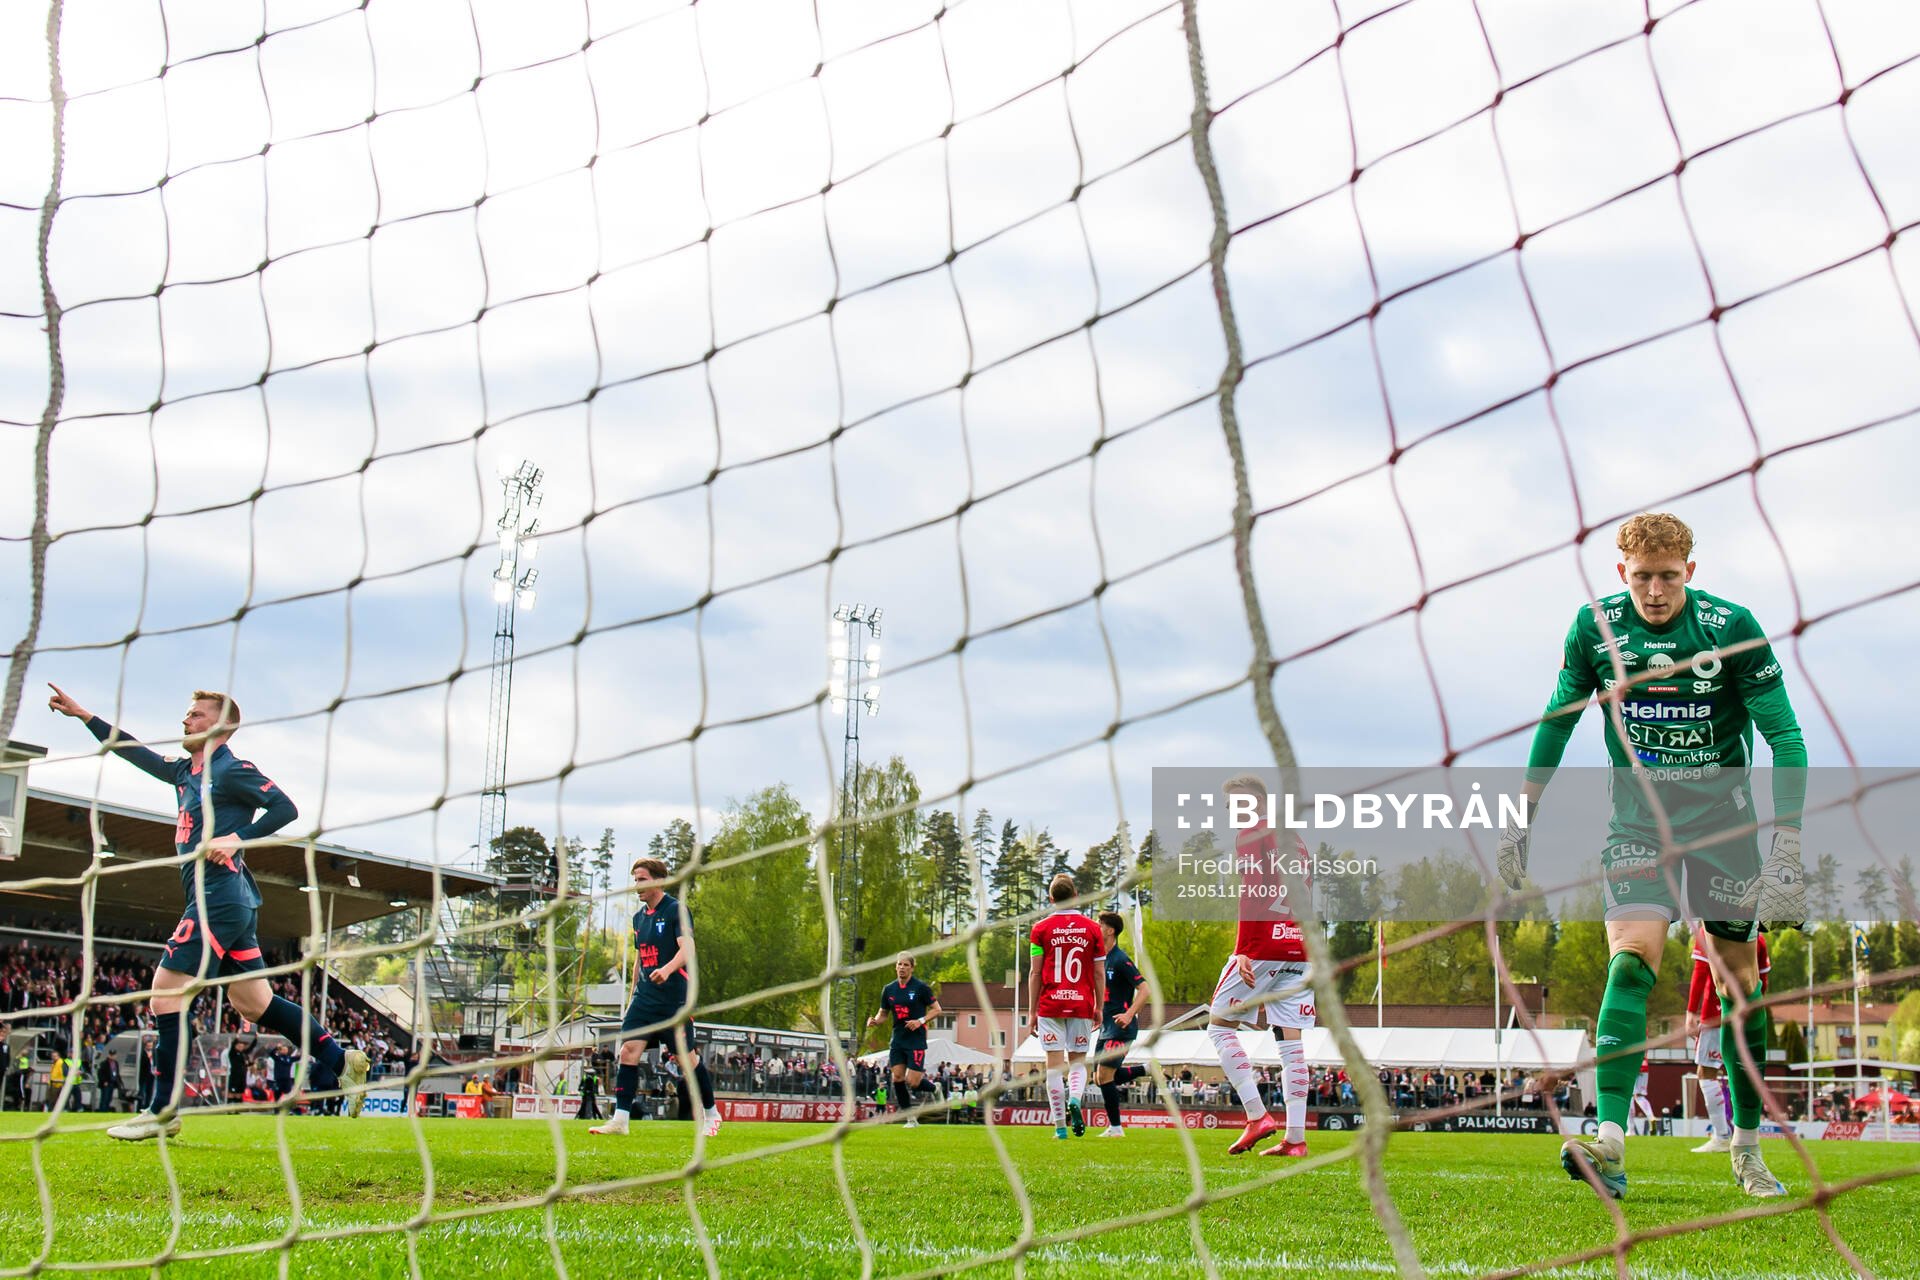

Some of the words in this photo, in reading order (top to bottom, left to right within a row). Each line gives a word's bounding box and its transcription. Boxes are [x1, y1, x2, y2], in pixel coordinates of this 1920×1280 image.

[1643, 641, 1677, 649] Helmia
[1621, 702, 1712, 719] Helmia
[1662, 750, 1721, 765] Munkfors
[1617, 881, 1631, 895] 25
[1050, 935, 1089, 948] OHLSSON
[1053, 946, 1085, 984] 16
[1043, 1033, 1057, 1042] ICA
[1075, 1036, 1088, 1044] ICA
[913, 1050, 925, 1062] 17
[1457, 1116, 1539, 1130] PALMQVIST
[1826, 1123, 1860, 1135] AQUA
